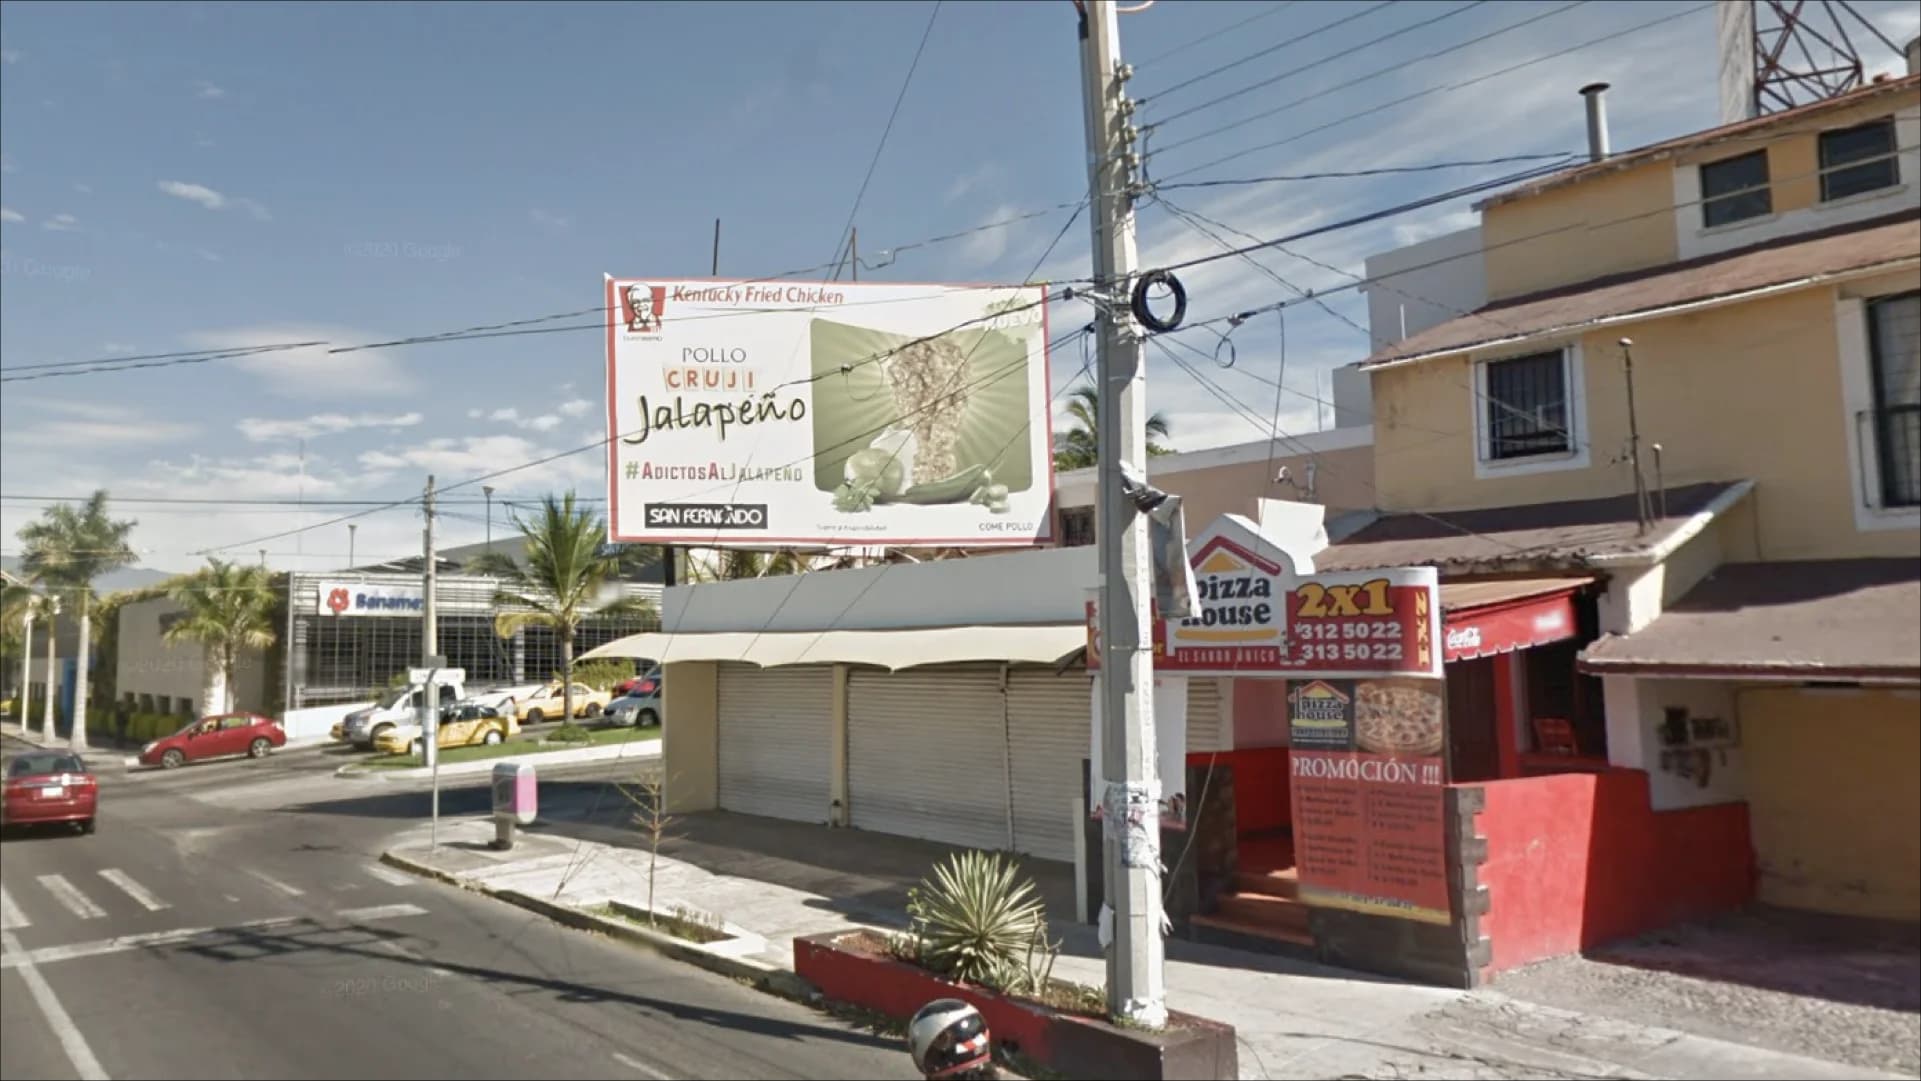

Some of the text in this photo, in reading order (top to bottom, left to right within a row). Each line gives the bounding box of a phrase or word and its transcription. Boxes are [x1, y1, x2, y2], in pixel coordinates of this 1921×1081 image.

[672, 285, 844, 305] Kentucky Fried Chicken
[682, 348, 747, 363] POLLO
[667, 370, 756, 389] CRUJI
[649, 508, 680, 524] SAN
[978, 522, 1034, 532] COME POLLO
[356, 593, 425, 610] Baname
[1181, 603, 1272, 626] ouse
[1301, 621, 1402, 640] 312 50 22
[1302, 643, 1403, 660] 313 50 22
[1293, 756, 1417, 784] PROMOCIÓN
